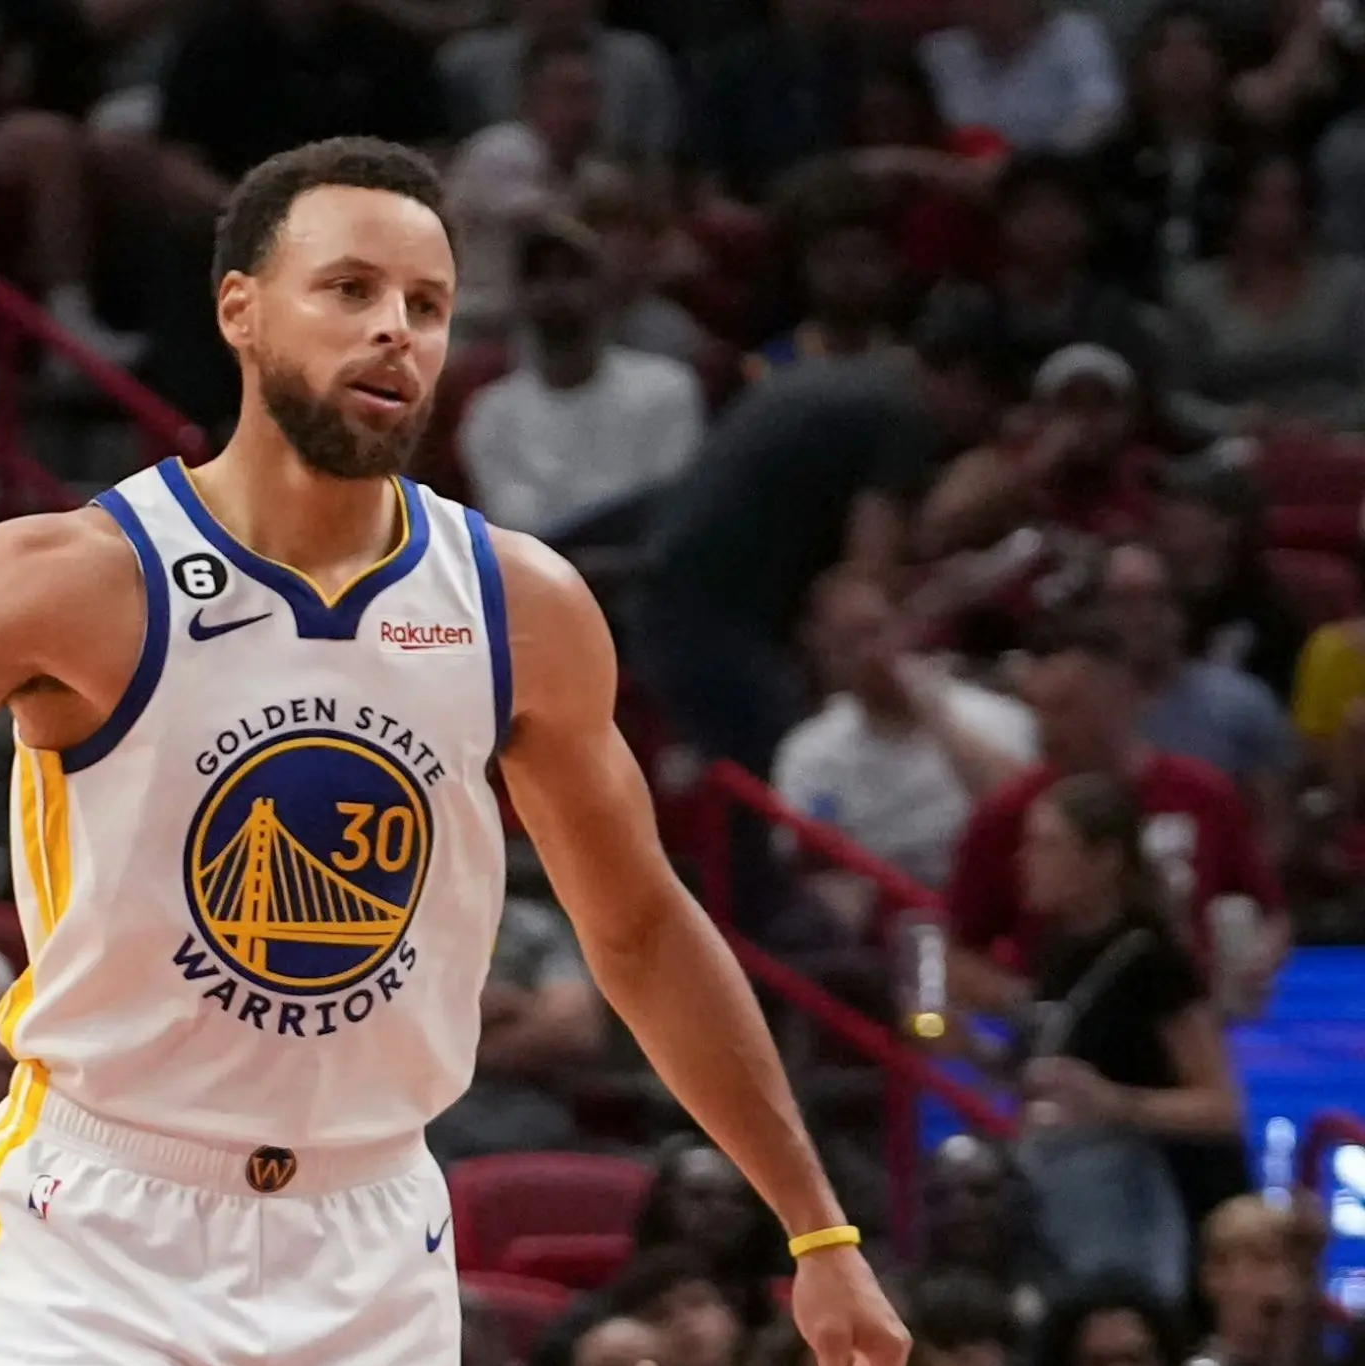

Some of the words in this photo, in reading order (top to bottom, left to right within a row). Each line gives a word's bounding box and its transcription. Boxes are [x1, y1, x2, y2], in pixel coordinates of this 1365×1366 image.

[181, 558, 218, 597] 6
[380, 621, 473, 647] Rakuten
[196, 697, 338, 777] GOLDEN
[354, 705, 446, 788] STATE
[329, 801, 415, 873] 30
[171, 932, 418, 1038] WARRIORS
